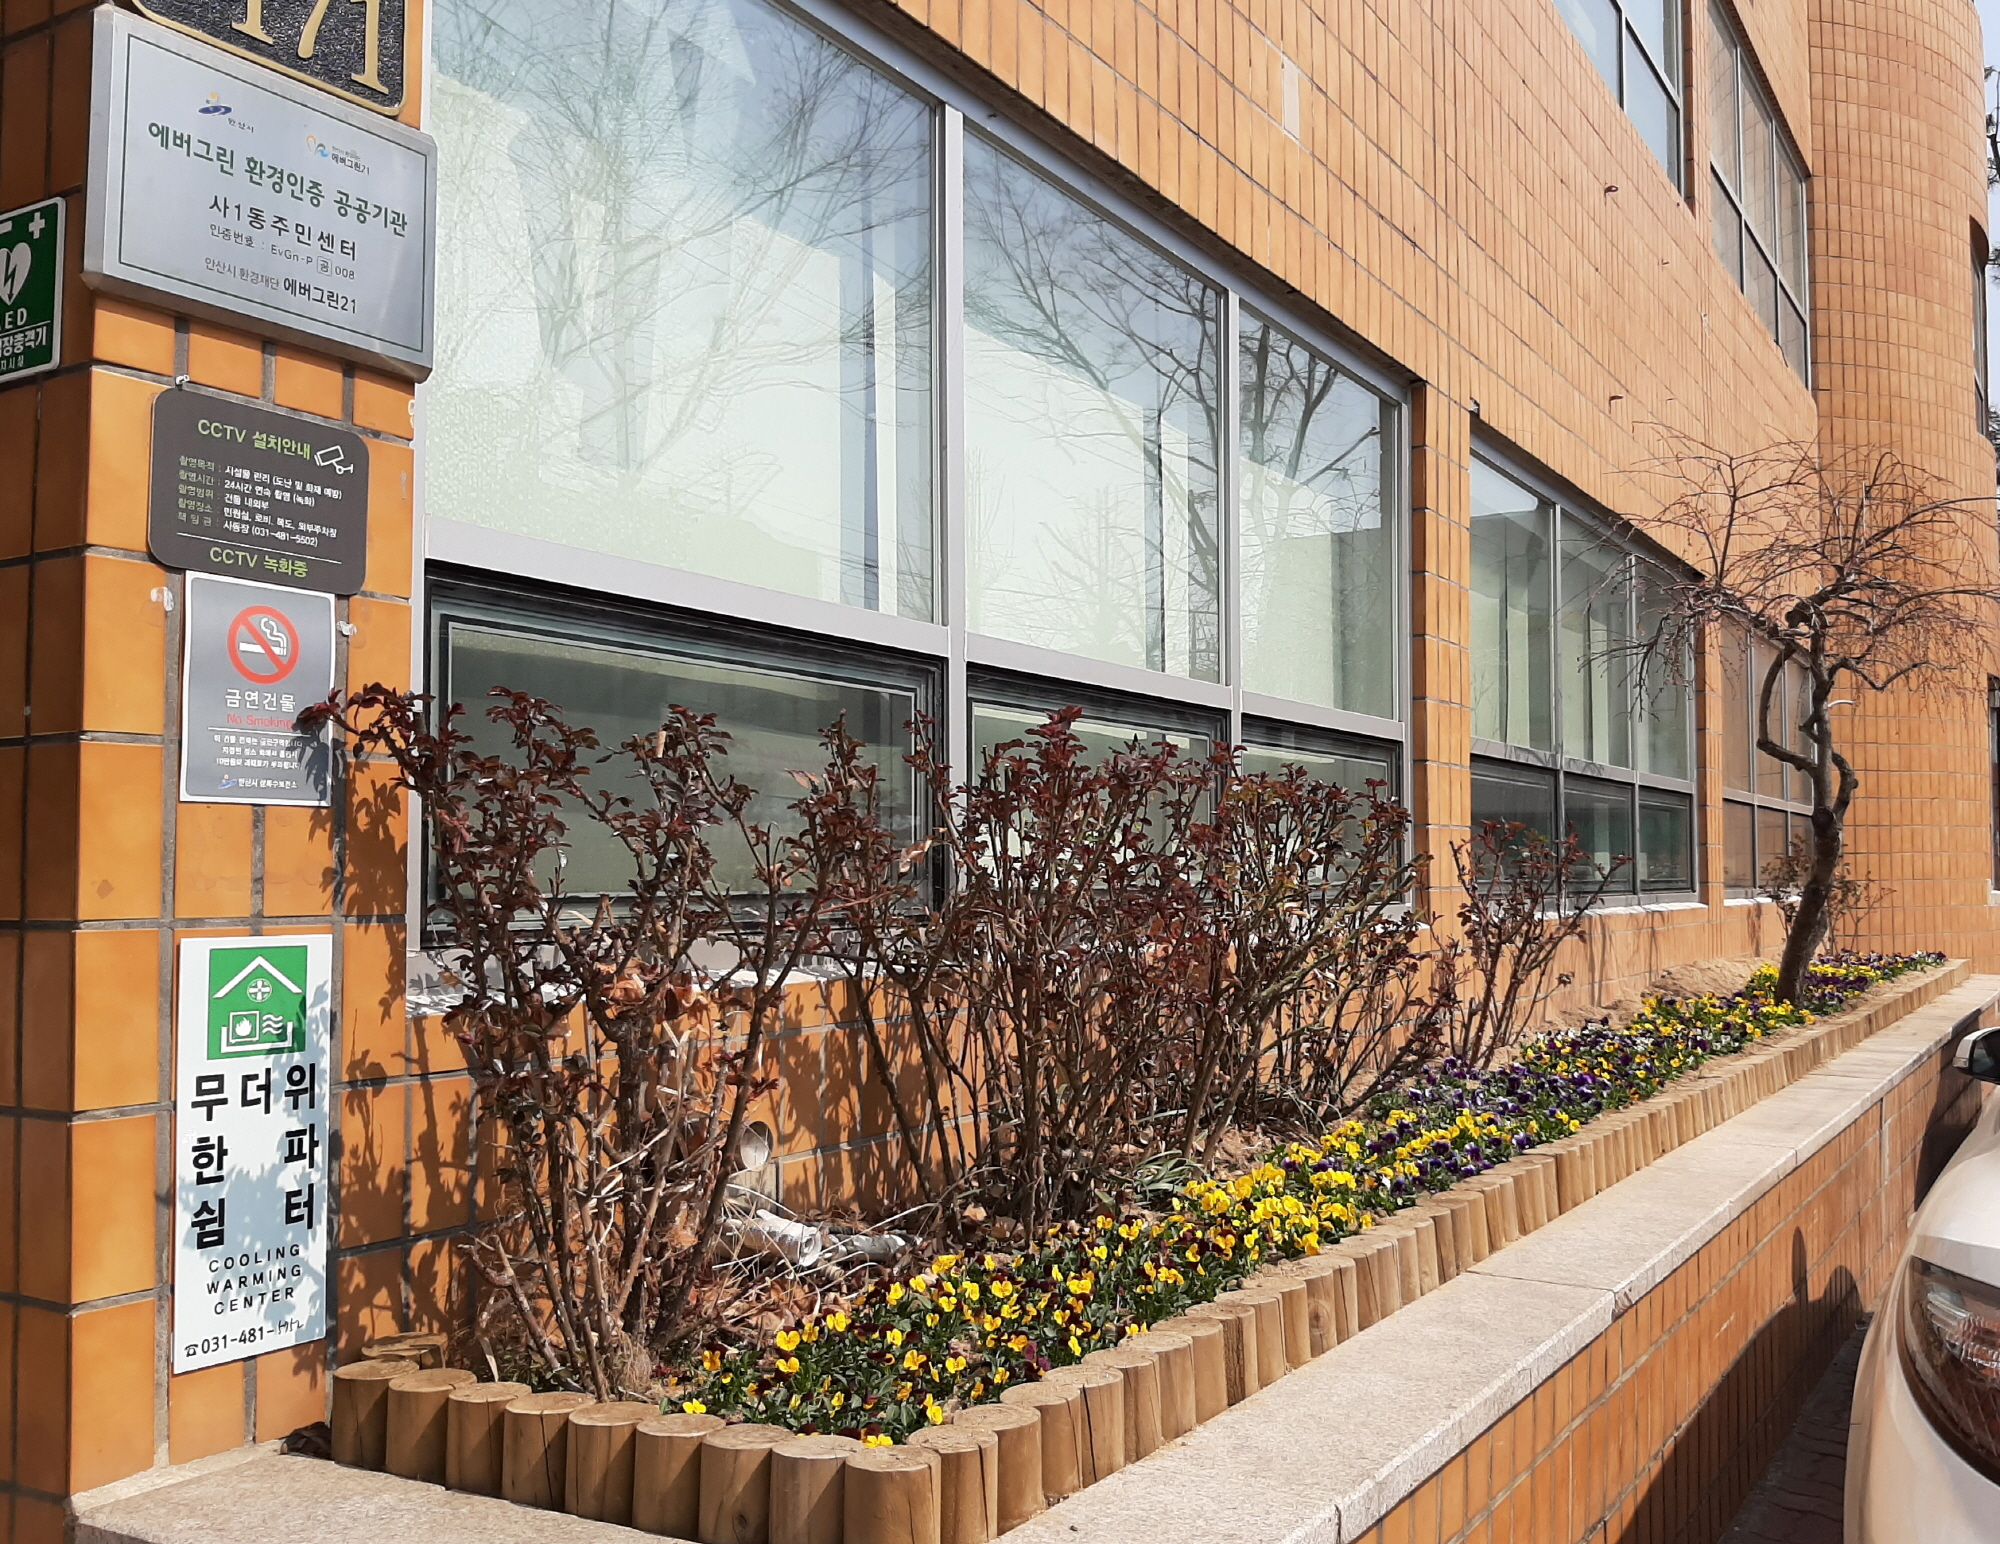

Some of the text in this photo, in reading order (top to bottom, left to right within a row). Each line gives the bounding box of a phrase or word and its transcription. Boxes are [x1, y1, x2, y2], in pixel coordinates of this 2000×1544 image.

[331, 153, 370, 175] 에버그린21
[148, 122, 408, 238] 에버그린 환경인증 공공기관
[271, 244, 313, 265] EvGn-P
[335, 266, 355, 280] 008
[205, 257, 356, 314] 안산시 환경재단 에버그린21
[0, 307, 27, 331] ED
[197, 419, 311, 460] CCTV 설치안내
[225, 465, 251, 480] 시설물
[224, 479, 252, 494] 24시간
[293, 493, 315, 508] (녹화)
[209, 546, 309, 578] CCTV 녹화중
[225, 688, 296, 713] 금연건물
[227, 713, 243, 725] No
[191, 1063, 316, 1121] 무더위
[209, 1244, 300, 1273] COOLING
[207, 1265, 301, 1294] WARMING
[214, 1287, 294, 1315] CENTER
